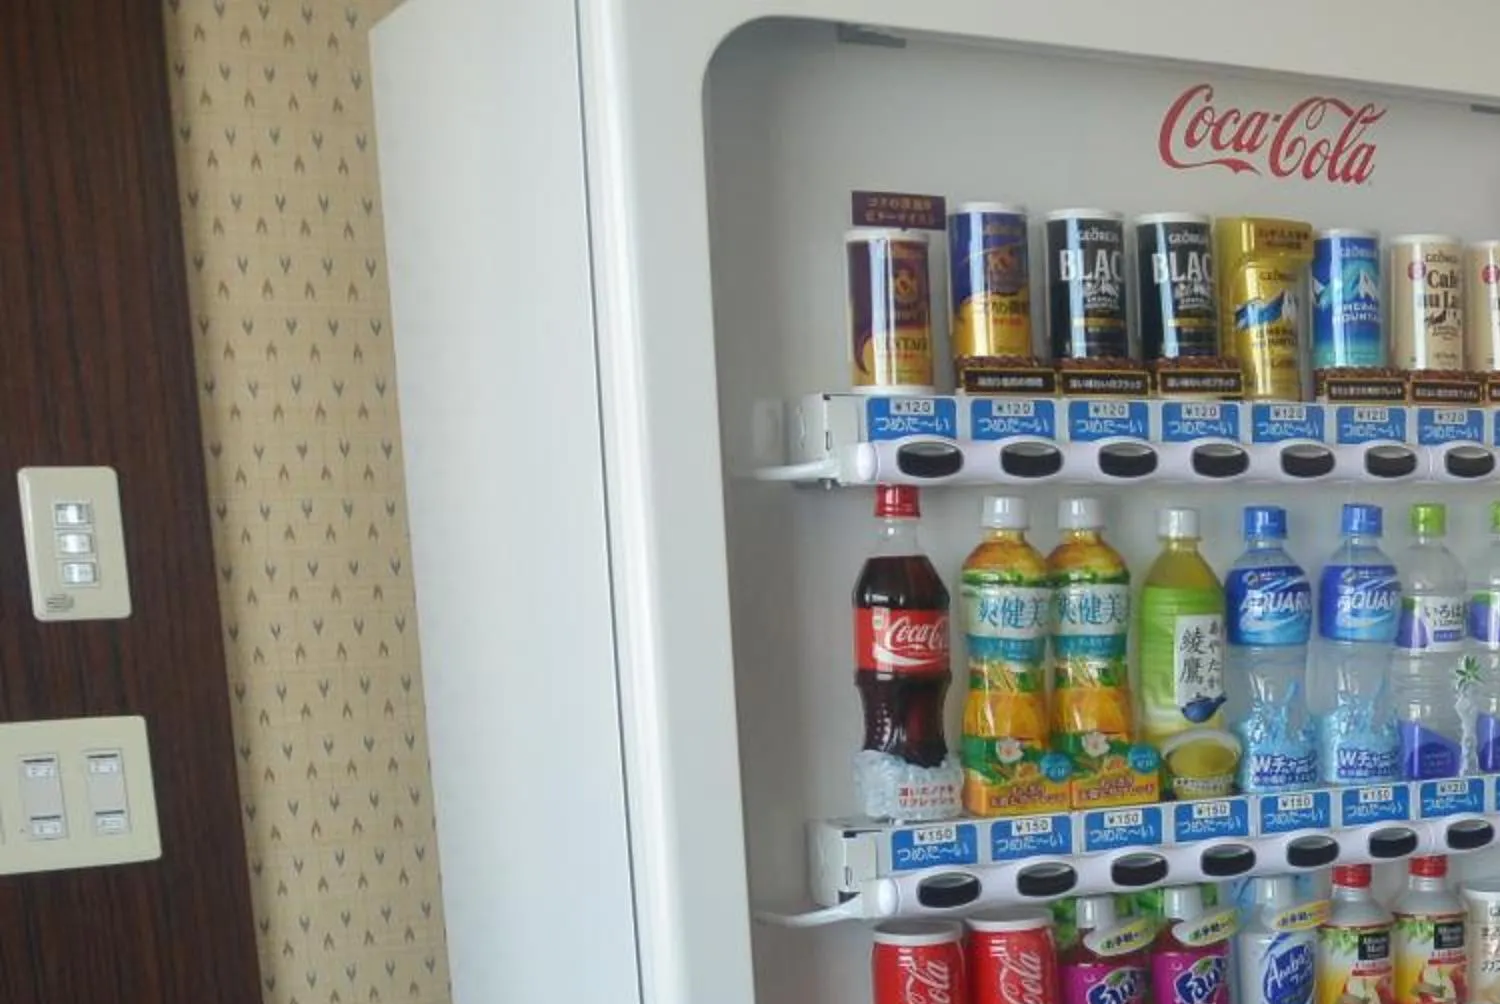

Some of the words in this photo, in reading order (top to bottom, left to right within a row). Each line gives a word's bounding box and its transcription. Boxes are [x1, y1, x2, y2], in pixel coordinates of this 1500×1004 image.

[1159, 84, 1387, 185] Coca-Cola
[1059, 248, 1124, 282] BLAC
[1152, 252, 1214, 284] BLAC
[1015, 819, 1049, 835] ¥150
[1107, 812, 1140, 826] ¥150
[918, 827, 953, 842] ¥150
